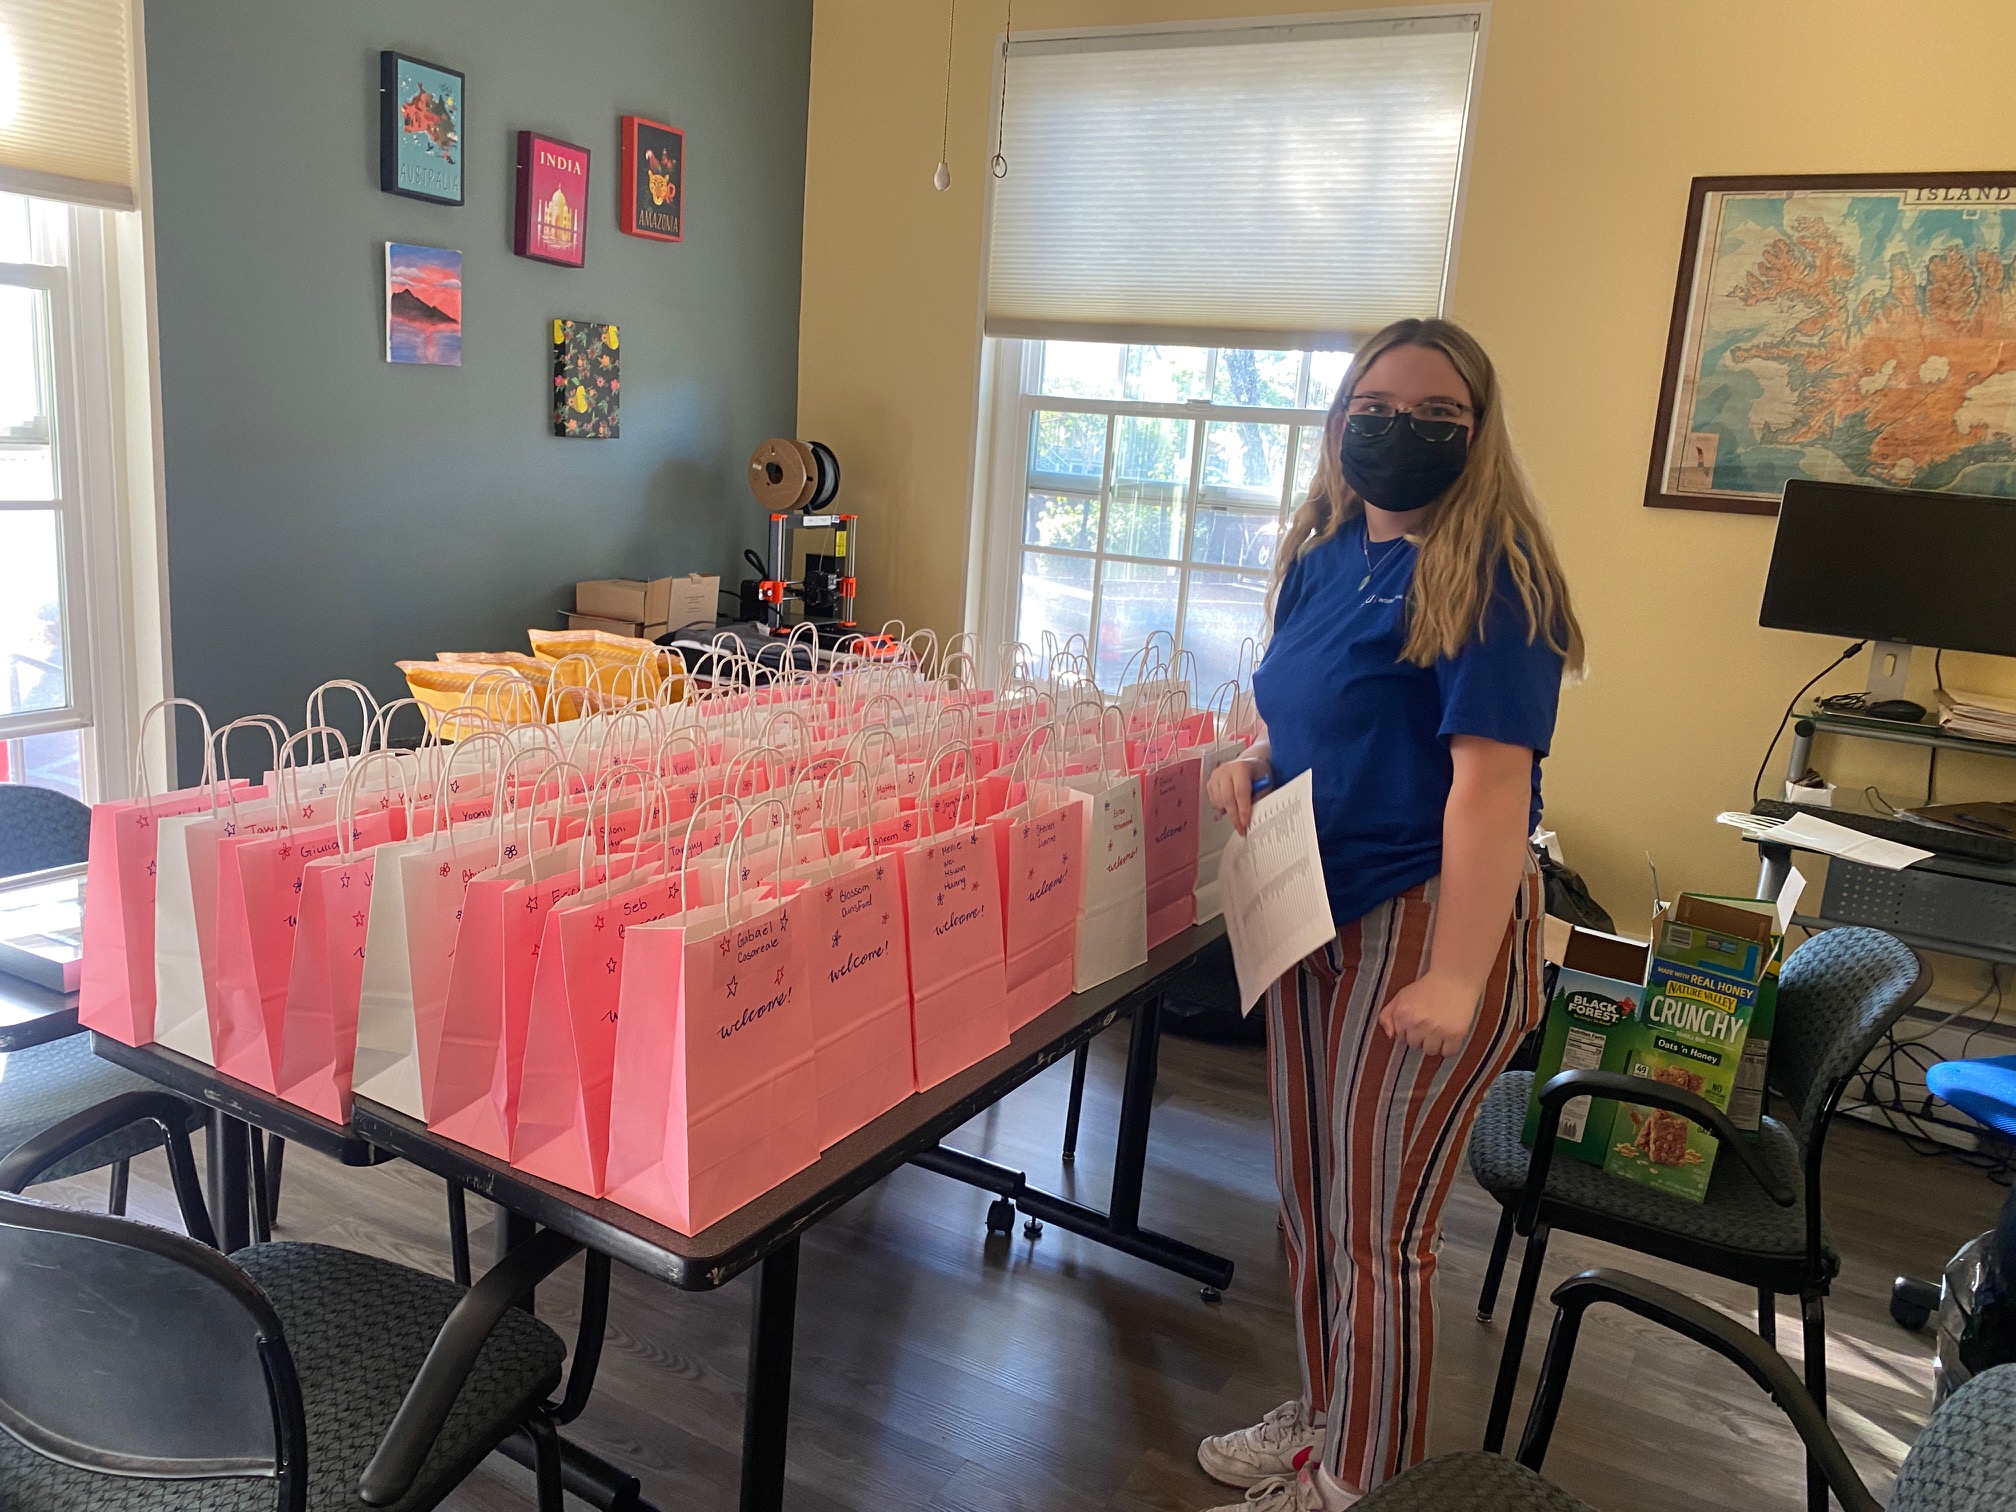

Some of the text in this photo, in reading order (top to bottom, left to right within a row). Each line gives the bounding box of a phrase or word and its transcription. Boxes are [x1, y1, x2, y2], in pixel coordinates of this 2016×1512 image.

[540, 151, 582, 175] INDIA
[400, 162, 460, 195] AUSTRALIA
[1915, 187, 2010, 201] ISLAND
[866, 833, 899, 850] Tsneem
[1155, 820, 1187, 844] welcome!
[1106, 847, 1138, 873] welcome!
[839, 884, 870, 903] Blossom
[1027, 869, 1068, 902] welcome!
[623, 899, 648, 916] Seb
[933, 904, 985, 936] welcome!
[828, 940, 889, 983] welcome!
[1657, 966, 1754, 999] MADE WITH REAL HONEY
[1573, 994, 1618, 1014] BLACK
[1667, 981, 1736, 1011] NATURE VALLEY
[717, 986, 793, 1039] welcome!
[1568, 1002, 1620, 1023] FOREST
[1649, 995, 1744, 1044] CRUNCHY
[1658, 1039, 1678, 1051] Oats
[1690, 1048, 1718, 1064] Honey
[1636, 1065, 1647, 1074] 49
[1711, 1083, 1723, 1093] NO
